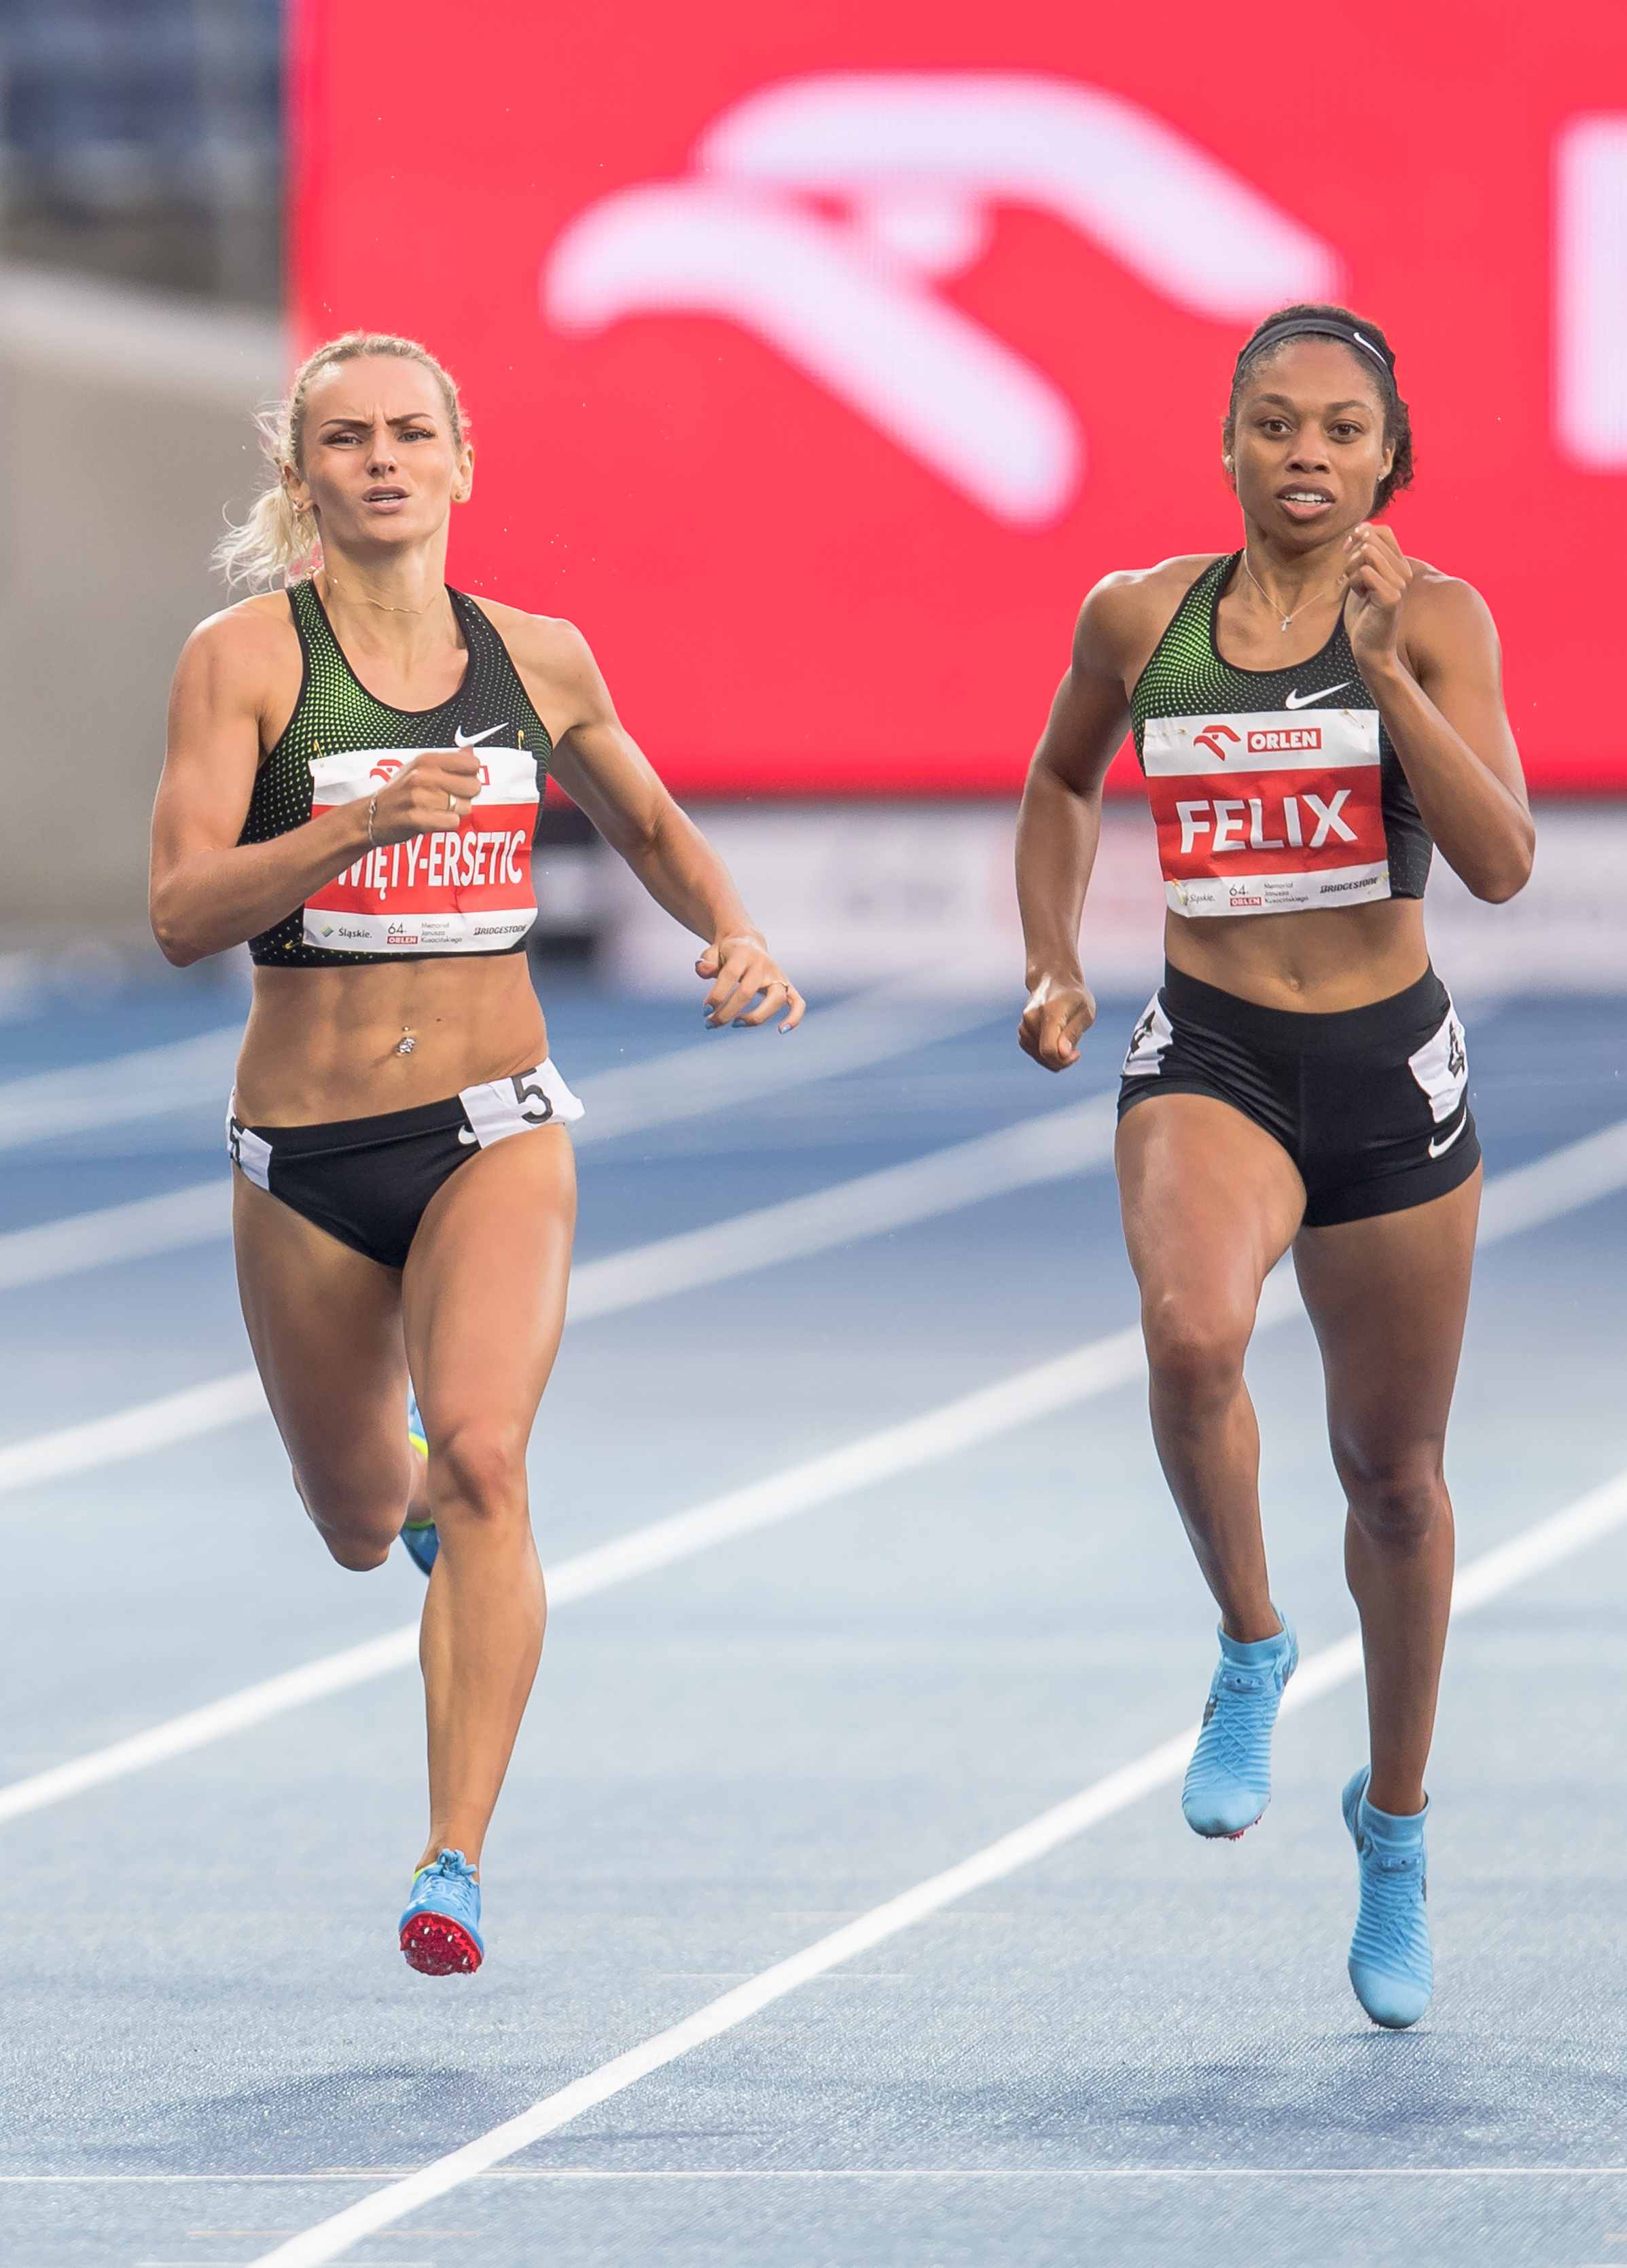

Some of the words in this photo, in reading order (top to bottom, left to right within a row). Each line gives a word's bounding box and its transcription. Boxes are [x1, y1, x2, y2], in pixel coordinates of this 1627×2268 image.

[1251, 730, 1318, 749] ORLEN
[1175, 789, 1359, 853] FELIX
[338, 829, 526, 901] WIĘTY-ERSETIC
[473, 924, 528, 936] BRIDGESTONE
[511, 1067, 554, 1125] 5
